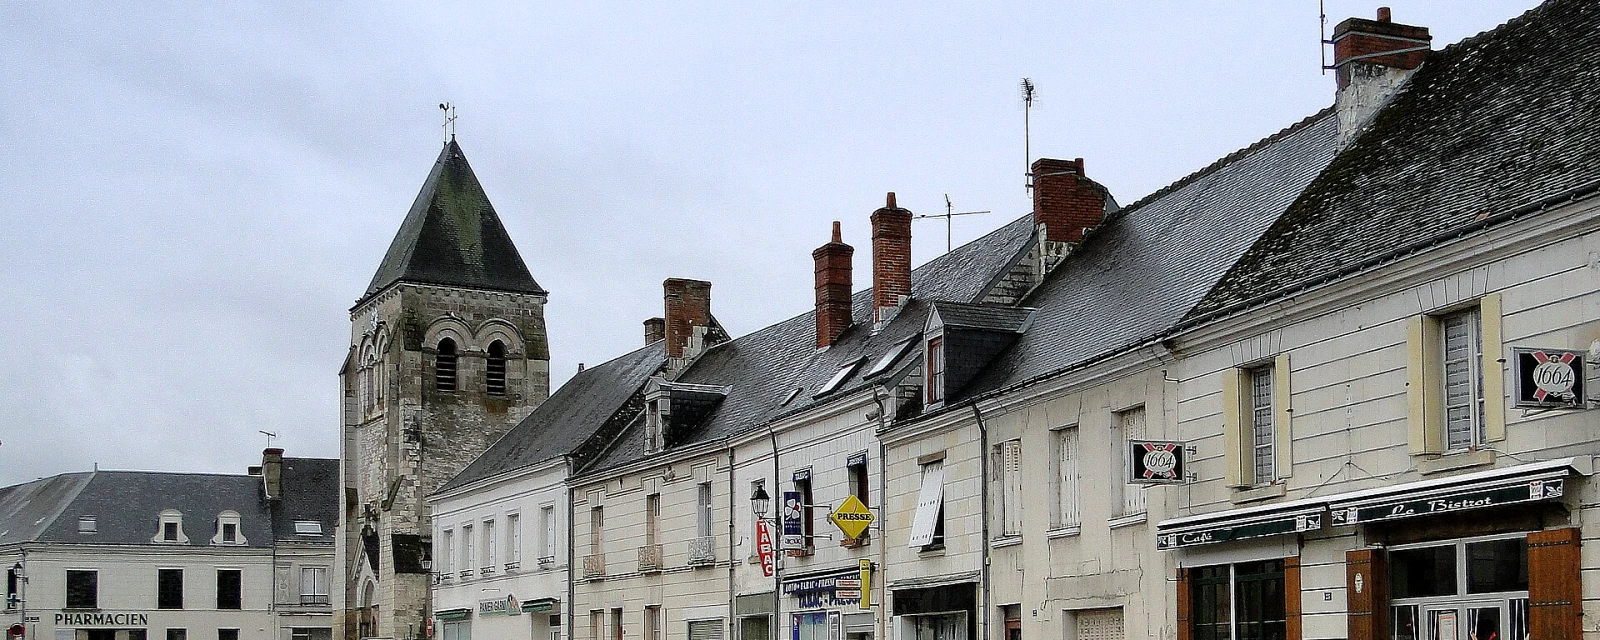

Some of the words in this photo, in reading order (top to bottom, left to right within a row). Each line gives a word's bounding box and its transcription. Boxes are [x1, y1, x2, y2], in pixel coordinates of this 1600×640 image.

[1537, 365, 1572, 387] 1664
[1146, 452, 1174, 468] 1664
[1386, 505, 1415, 518] Le
[1427, 496, 1493, 512] Bistrot
[837, 513, 872, 521] PRESSE
[1182, 532, 1213, 544] Café
[759, 522, 773, 574] TABAC
[54, 613, 148, 626] PHARMACIEN
